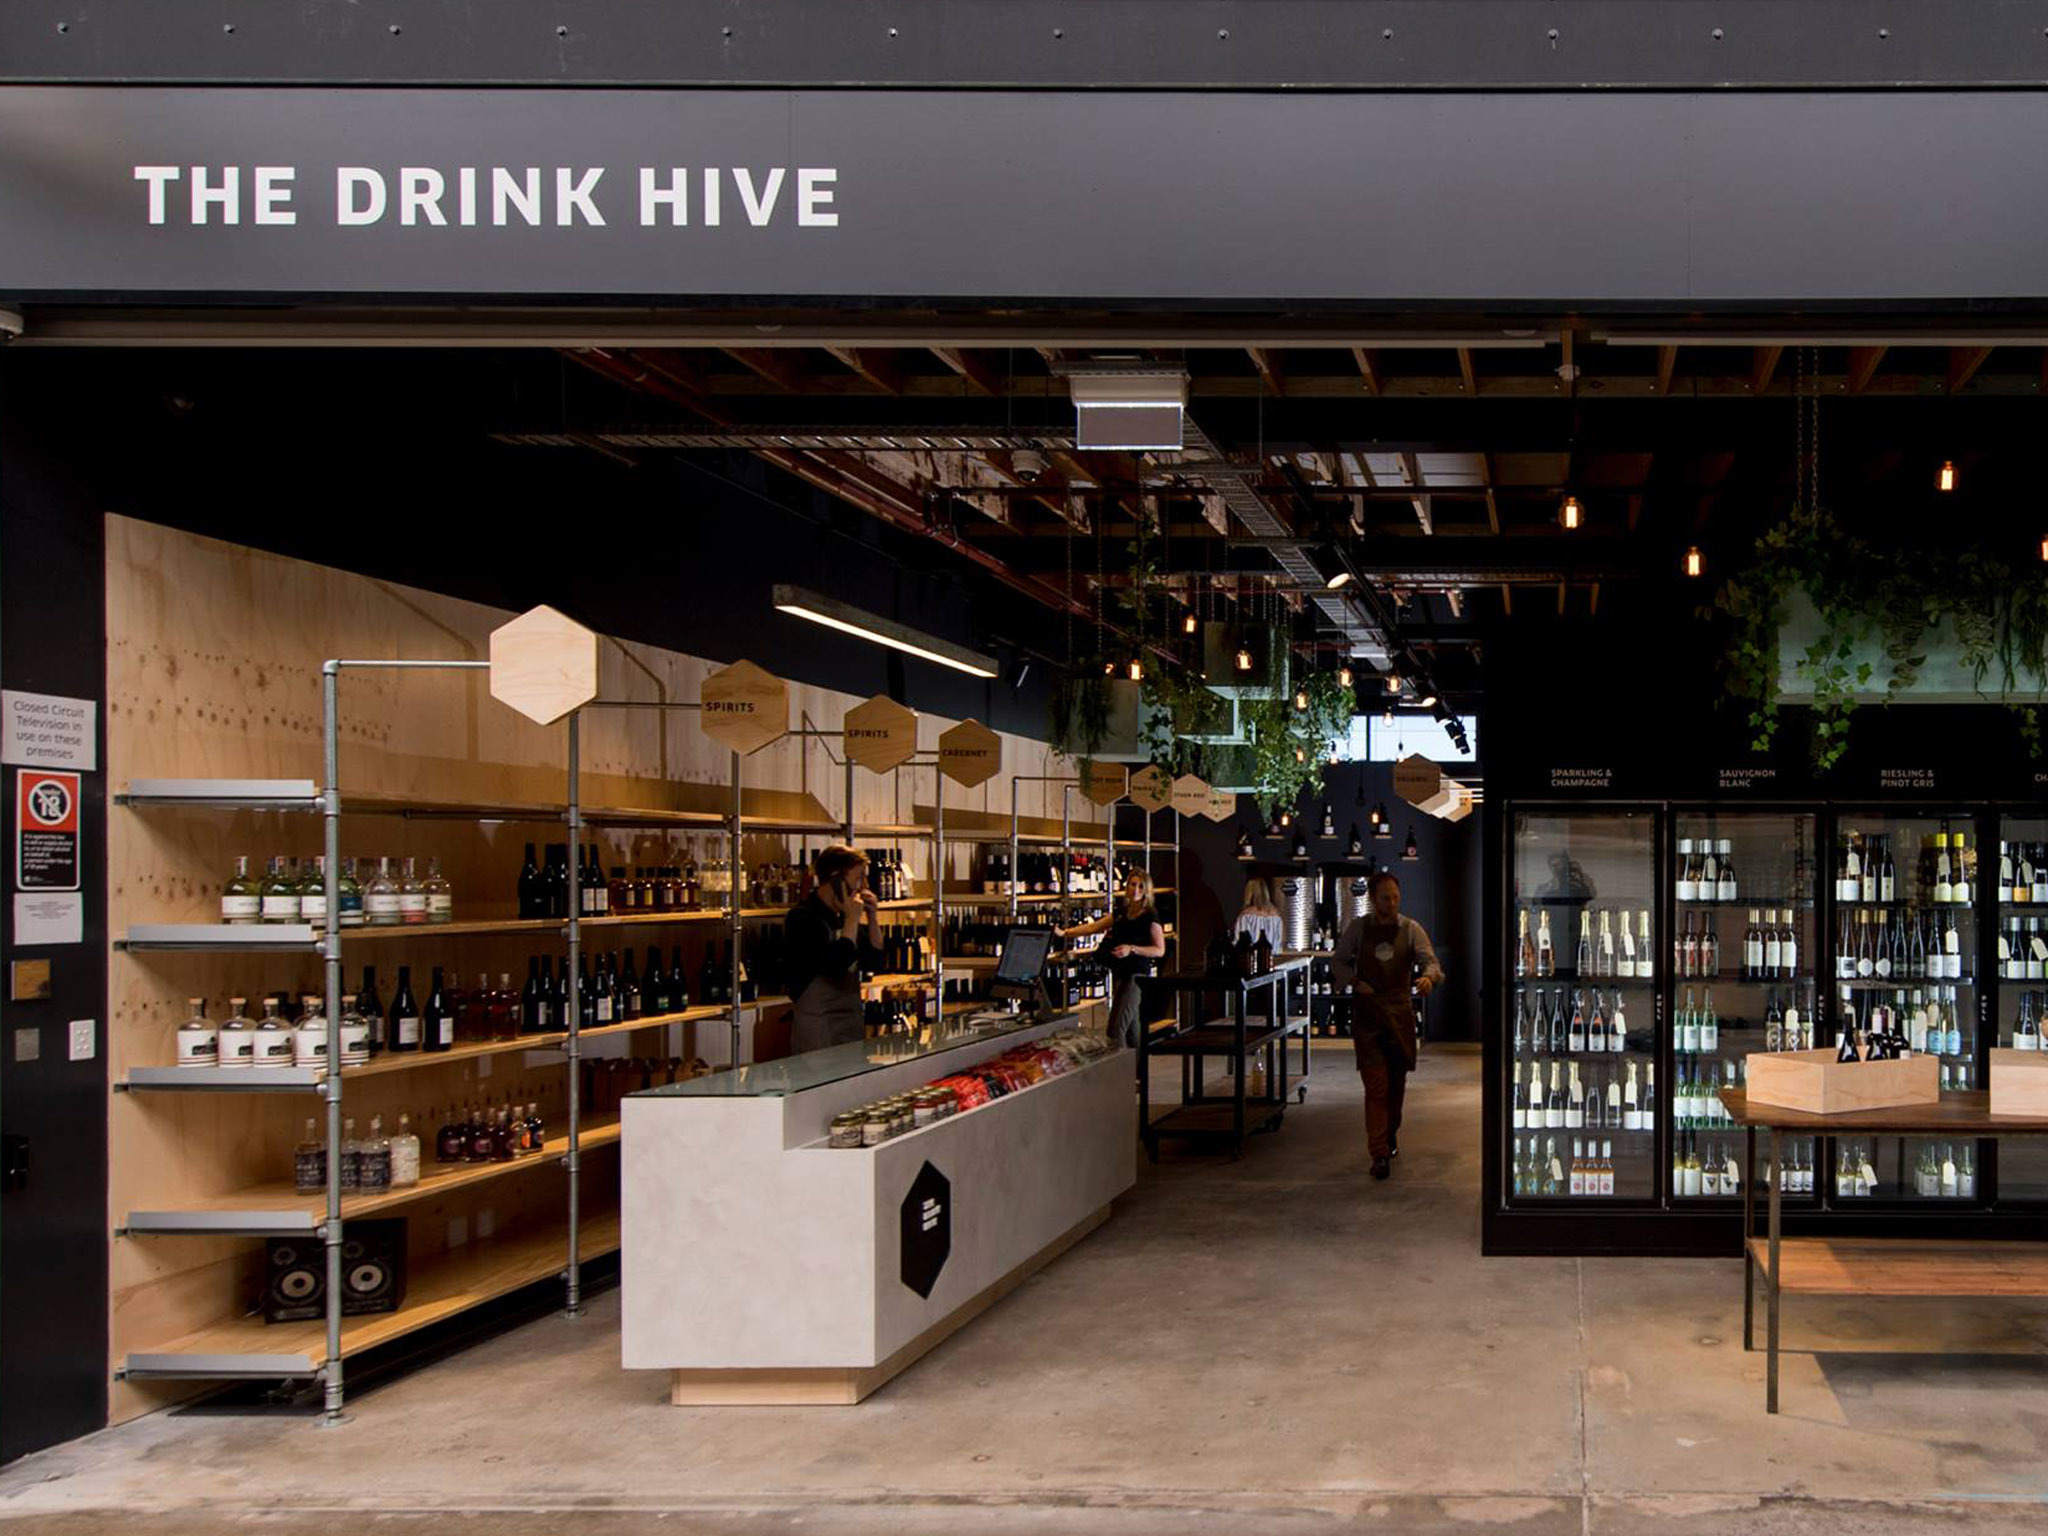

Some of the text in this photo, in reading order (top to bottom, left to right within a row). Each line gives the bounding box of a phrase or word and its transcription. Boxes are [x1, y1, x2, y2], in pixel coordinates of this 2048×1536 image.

[134, 166, 840, 227] THE DRINK HIVE
[13, 700, 85, 718] Closed Circuit
[705, 702, 755, 713] SPIRITS
[16, 715, 83, 731] Television in
[847, 729, 889, 738] SPIRITS
[16, 732, 82, 747] use on these
[26, 747, 74, 760] premises
[1551, 769, 1613, 778] SPARKLING &
[1719, 769, 1777, 778] SAUVIGNON
[1880, 769, 1934, 778] RIESLING &
[2034, 773, 2048, 782] CH
[1551, 778, 1609, 787] CHAMPAGNE
[1719, 779, 1751, 788] BLANC
[1880, 779, 1935, 788] PINOT GRIS
[38, 795, 61, 817] 18
